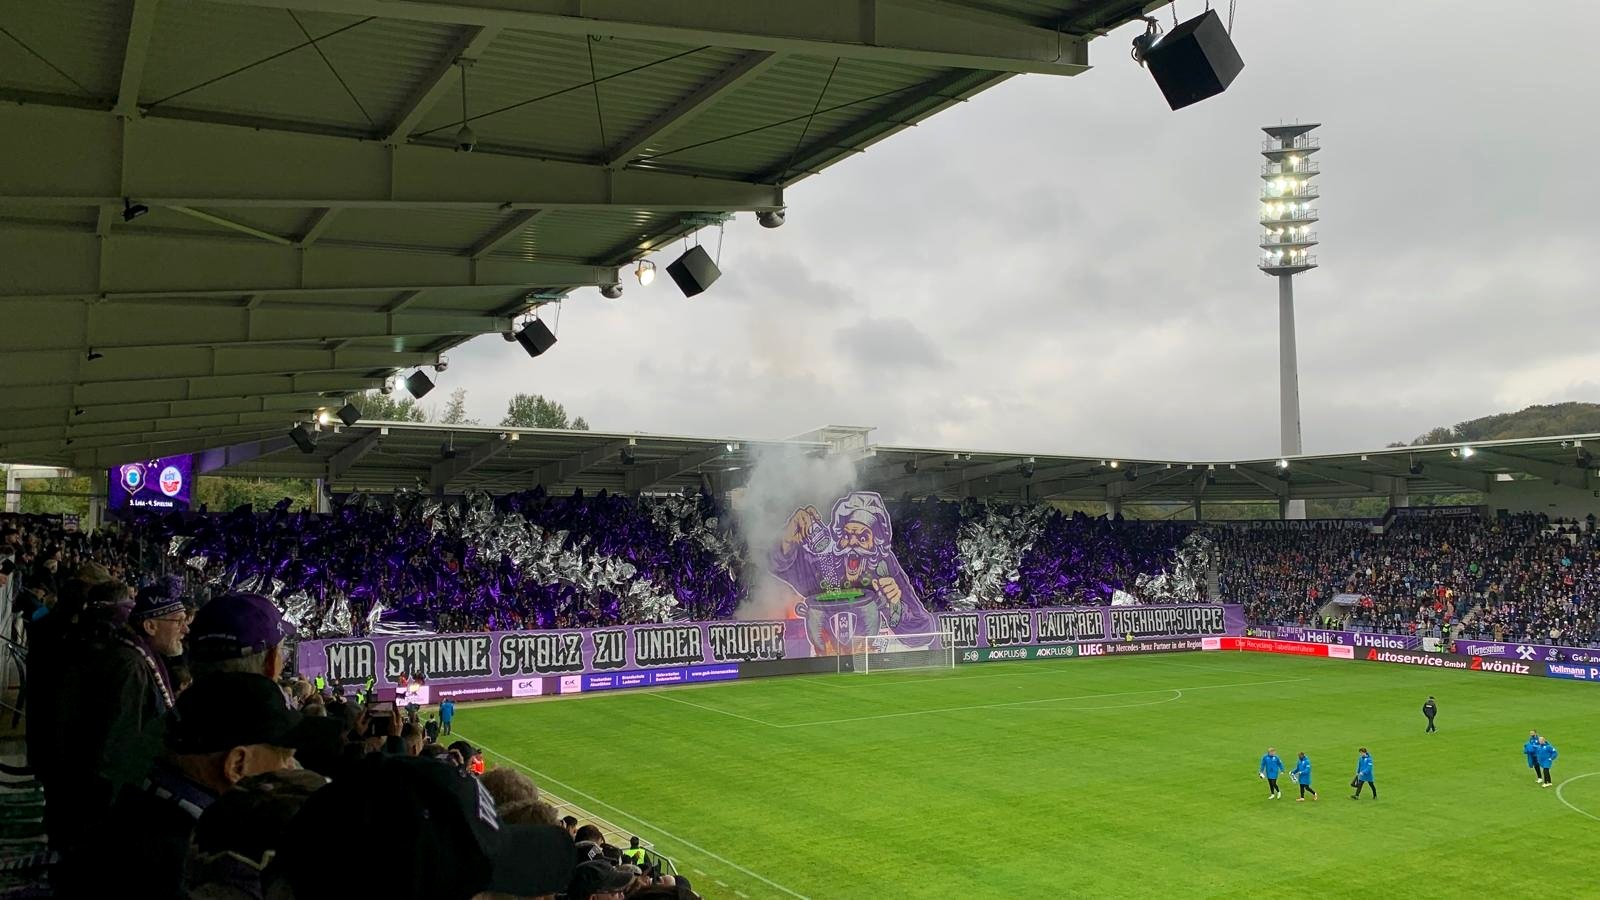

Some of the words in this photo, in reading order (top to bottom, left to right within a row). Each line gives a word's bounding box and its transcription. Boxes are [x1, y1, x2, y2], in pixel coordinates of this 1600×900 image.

[1106, 644, 1114, 652] Ihr
[1115, 643, 1153, 653] Mercedes-Benz
[1153, 642, 1171, 651] Partner
[1178, 641, 1186, 649] der
[1187, 640, 1202, 649] Region
[1364, 635, 1405, 650] Helios
[386, 637, 492, 679] STINNE
[499, 633, 582, 669] STOLZ
[592, 630, 625, 664] ZU
[708, 623, 784, 658] TRUPPE
[1367, 648, 1443, 666] Autoservice
[1443, 660, 1467, 669] GmbH
[1470, 655, 1530, 674] Zwönitz
[1549, 664, 1586, 677] Vollmann
